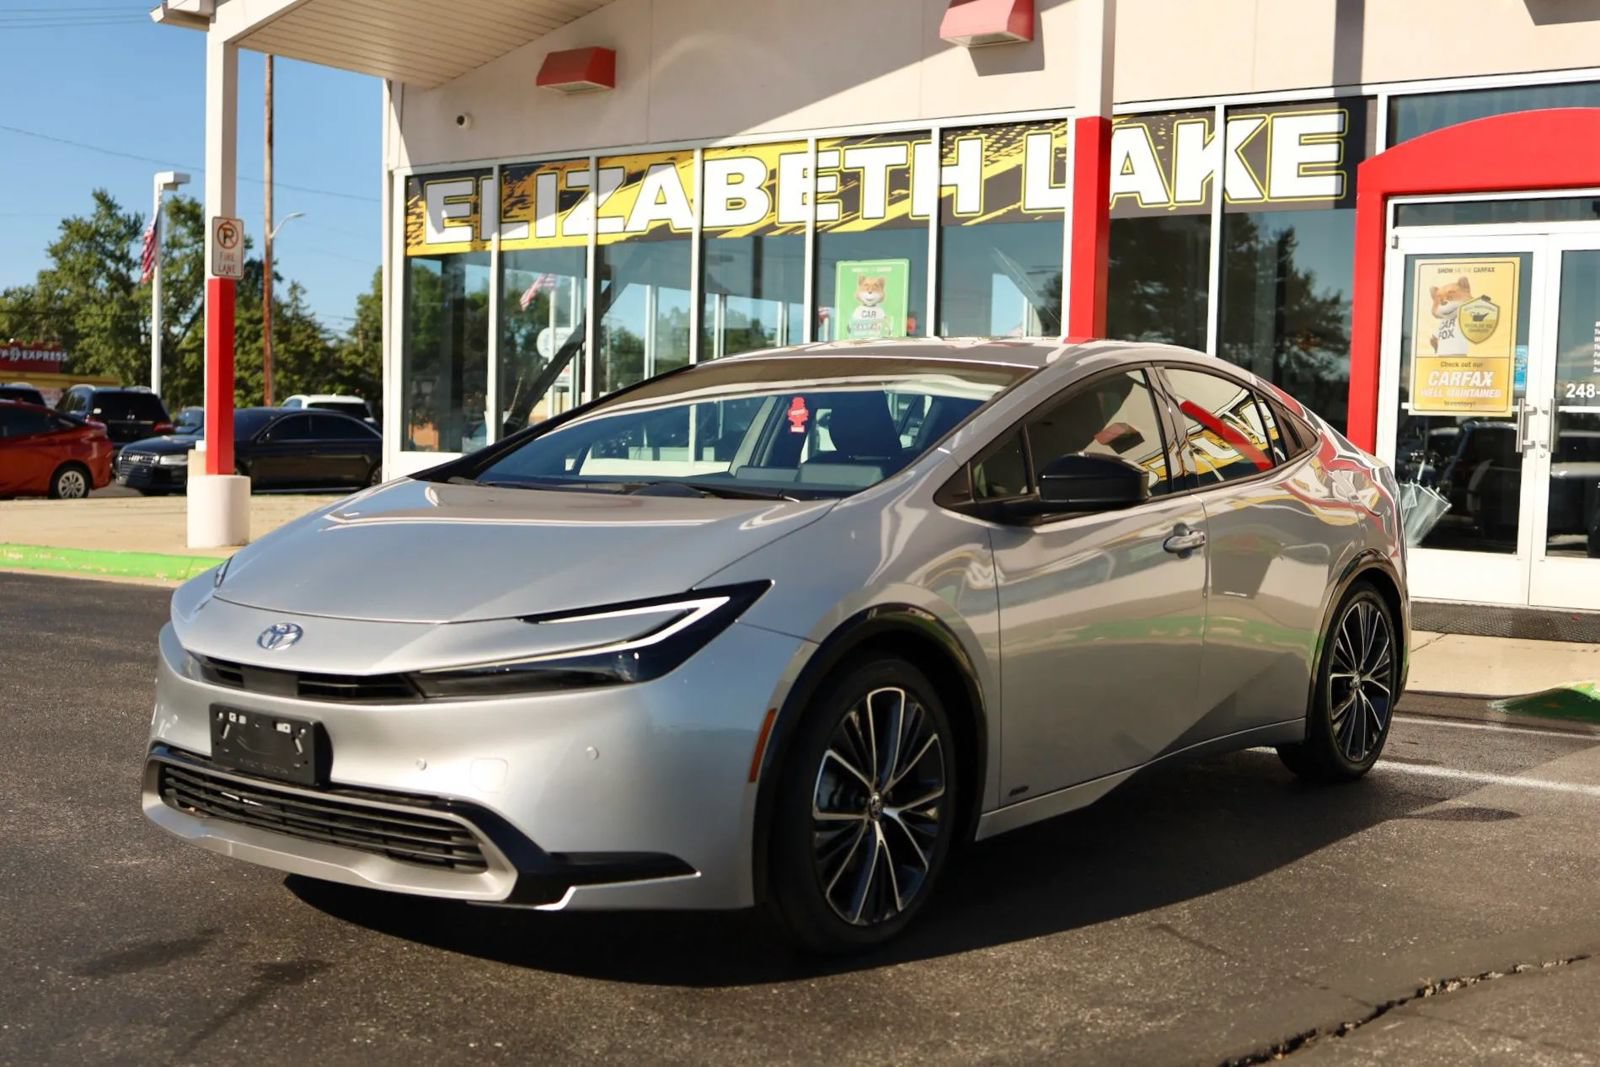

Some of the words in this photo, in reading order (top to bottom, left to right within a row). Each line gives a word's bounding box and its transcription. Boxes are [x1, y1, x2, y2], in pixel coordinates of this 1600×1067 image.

[423, 135, 985, 245] ELIZABETH
[1021, 109, 1348, 213] LAKE
[218, 263, 236, 273] LANE
[861, 310, 877, 318] CAR
[22, 350, 69, 362] EXPRESS
[1427, 370, 1496, 387] CARFAX
